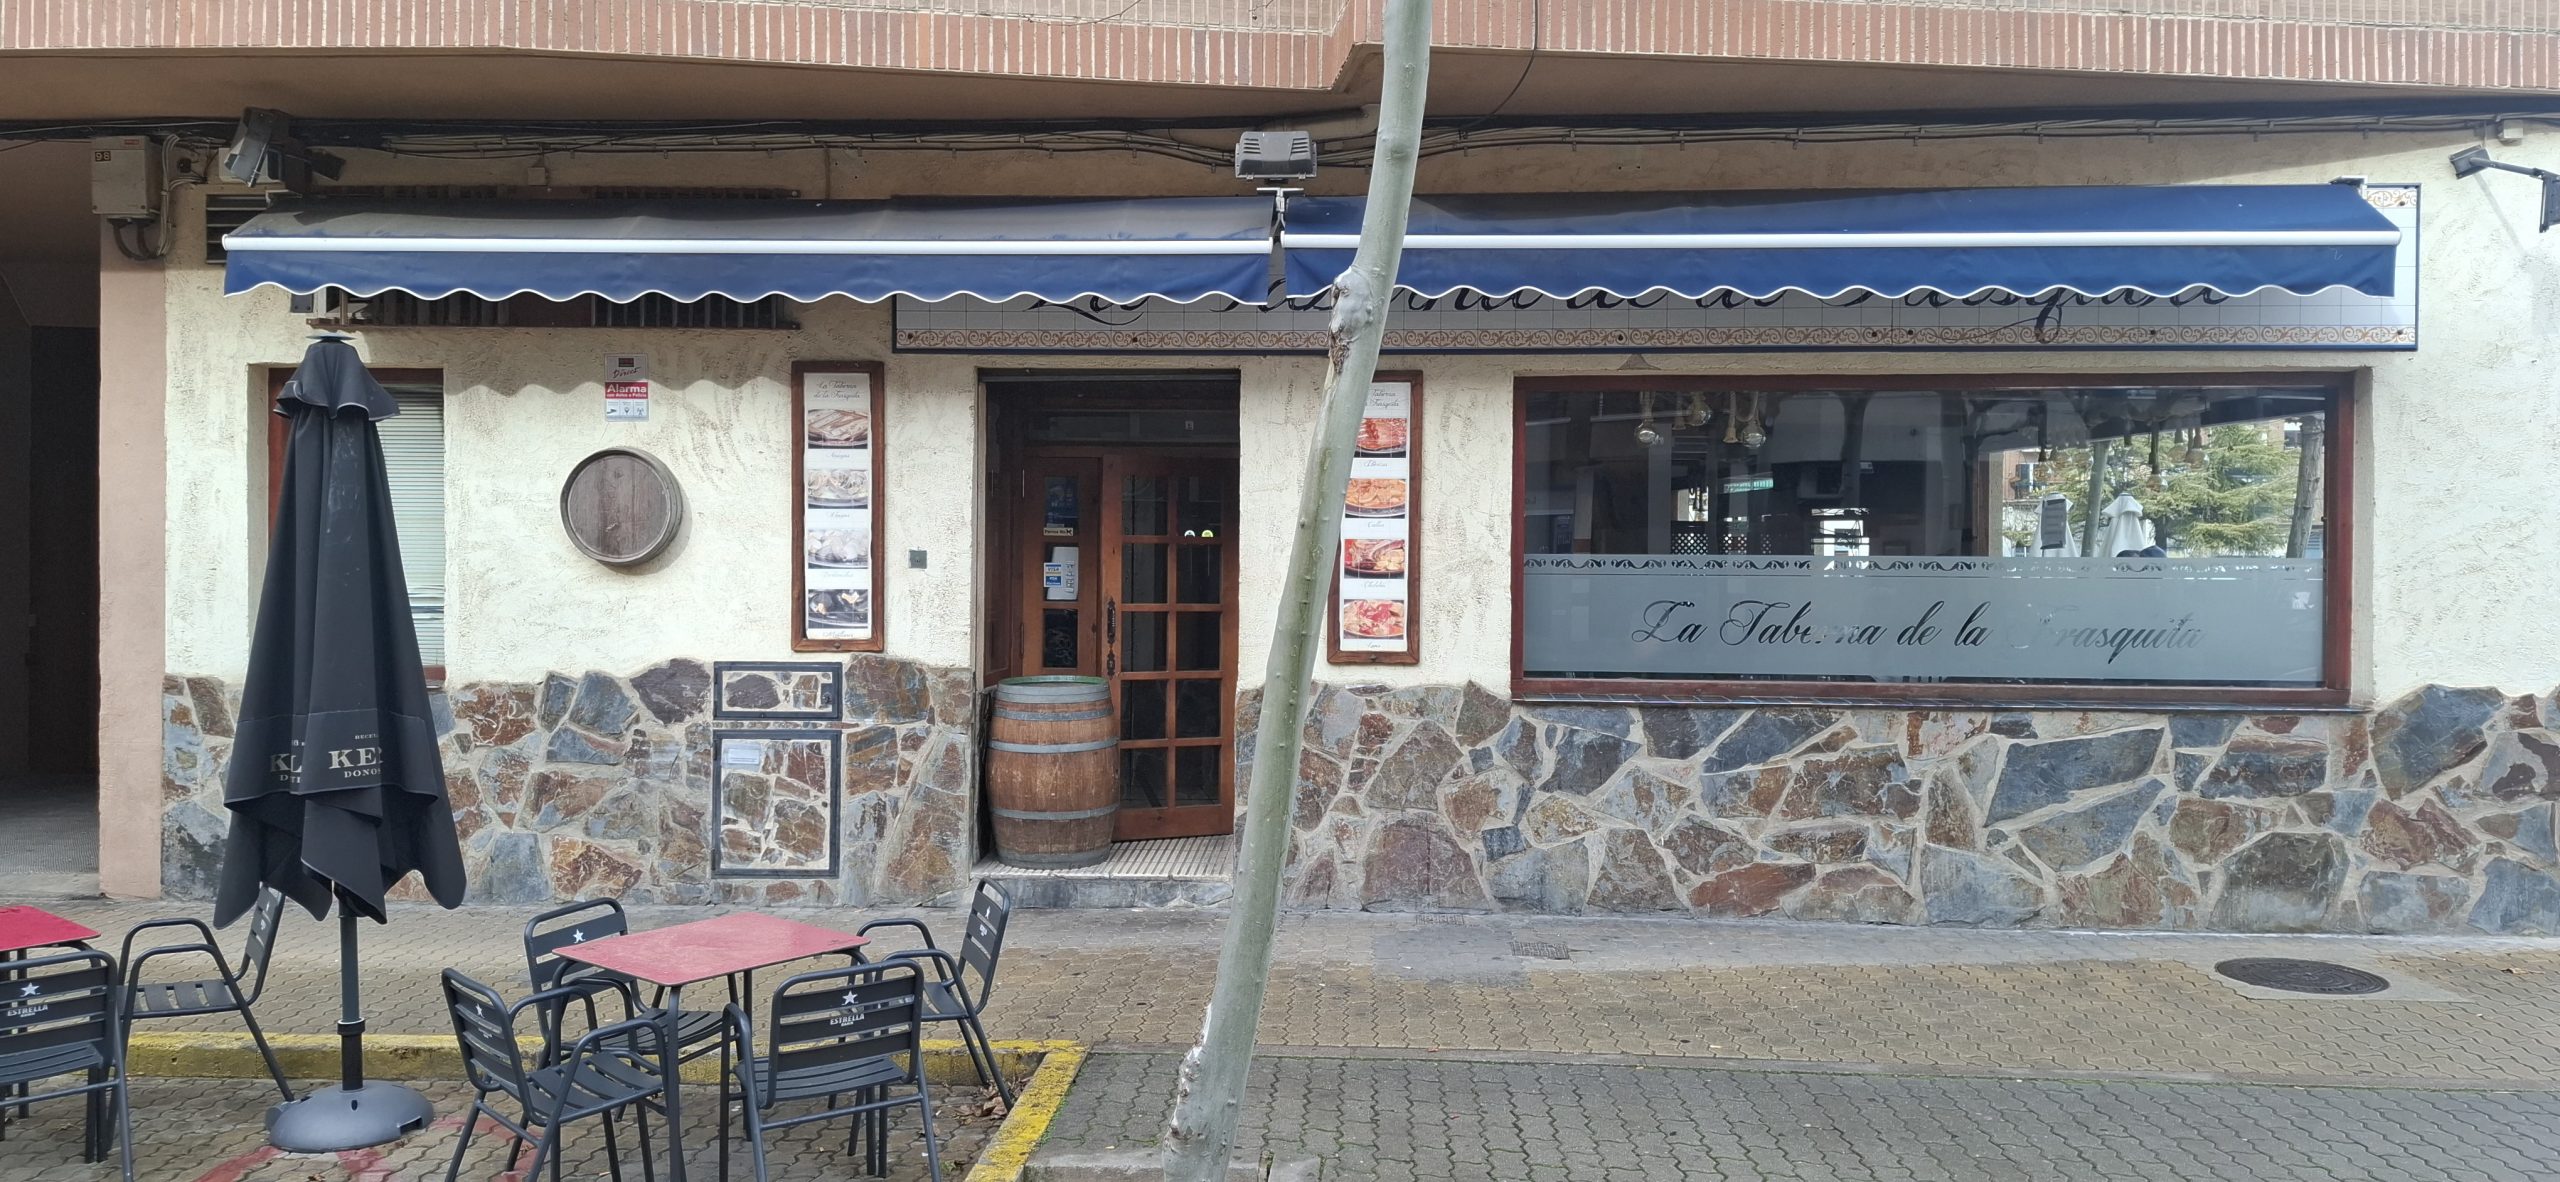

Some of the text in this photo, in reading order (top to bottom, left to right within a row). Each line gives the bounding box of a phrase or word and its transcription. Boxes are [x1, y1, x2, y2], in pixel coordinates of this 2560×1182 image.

[606, 383, 647, 393] Alarma
[1632, 599, 1707, 643] La
[1897, 600, 1942, 646] de
[1954, 600, 1992, 647] la
[7, 1004, 48, 1017] ESTRELLA
[830, 1013, 865, 1026] ESTRELLA
